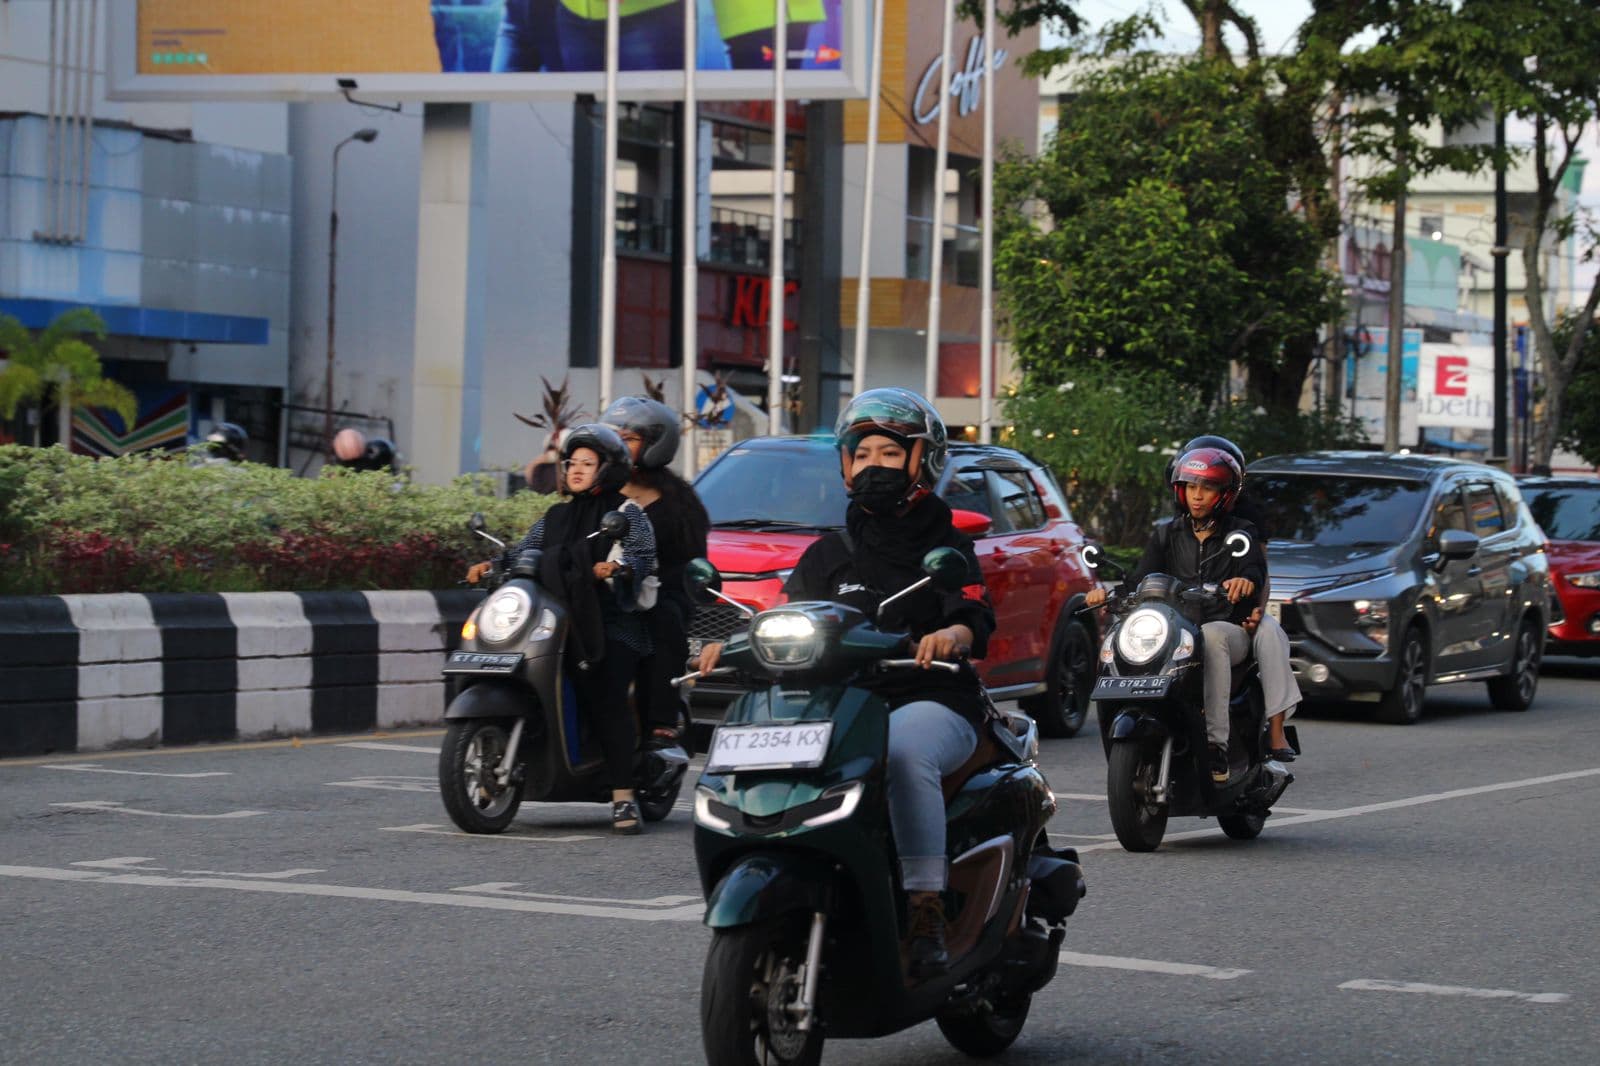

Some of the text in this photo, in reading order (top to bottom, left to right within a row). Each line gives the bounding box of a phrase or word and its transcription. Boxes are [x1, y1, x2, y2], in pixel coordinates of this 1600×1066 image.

[913, 35, 1008, 124] Coffe
[1100, 680, 1115, 689] KT
[717, 728, 825, 750] KT 2354 KX
